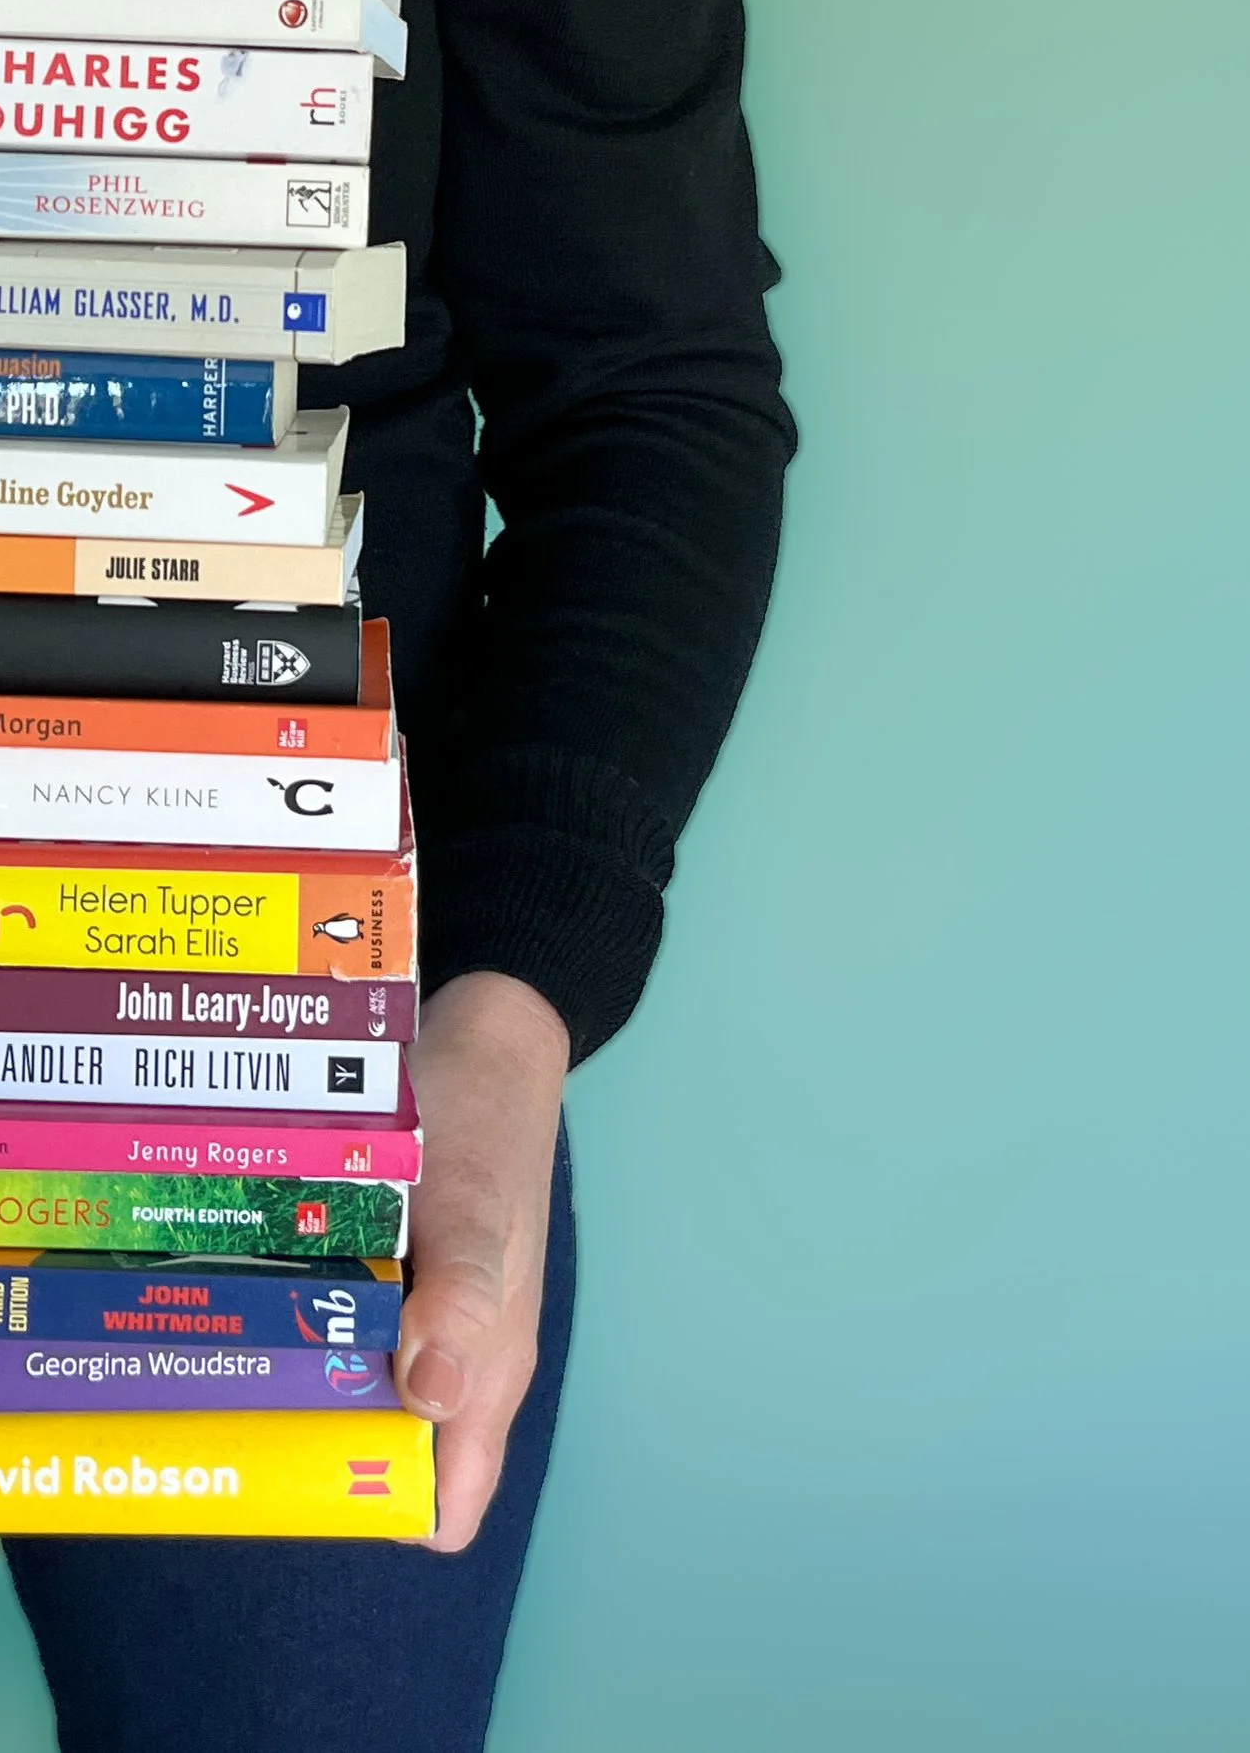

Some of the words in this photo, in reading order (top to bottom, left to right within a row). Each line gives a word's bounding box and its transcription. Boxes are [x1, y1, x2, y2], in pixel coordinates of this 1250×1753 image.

[88, 174, 147, 194] PHIL
[35, 194, 206, 219] ROSENZWEIG
[74, 289, 176, 323] GLASSER,
[190, 294, 240, 323] M.D.
[202, 358, 219, 437] HARPER
[56, 481, 153, 513] Goyder
[106, 556, 146, 580] JULIE
[151, 558, 199, 582] STARR
[221, 641, 231, 683] Harvard
[33, 783, 131, 806] NANCY
[147, 786, 219, 809] KLINE
[60, 884, 146, 914] Helen
[157, 886, 266, 924] Tupper
[85, 927, 175, 955] Sarah
[187, 929, 239, 958] Ellis
[370, 889, 384, 969] BUSINESS
[116, 981, 172, 1021] John
[182, 983, 329, 1034] Leary-Joyce
[135, 1048, 195, 1088] RICH
[209, 1051, 290, 1092] LITVIN
[127, 1140, 198, 1168] Jenny
[208, 1142, 288, 1170] Rogers
[132, 1206, 194, 1223] FOURTH
[198, 1208, 263, 1224] EDITION
[8, 1276, 29, 1333] EDITION
[138, 1286, 209, 1307] JOHN
[103, 1311, 243, 1335] WHITMORE
[26, 1351, 142, 1381] Georgina
[148, 1351, 271, 1377] Woudstra
[72, 1456, 240, 1496] Robson
